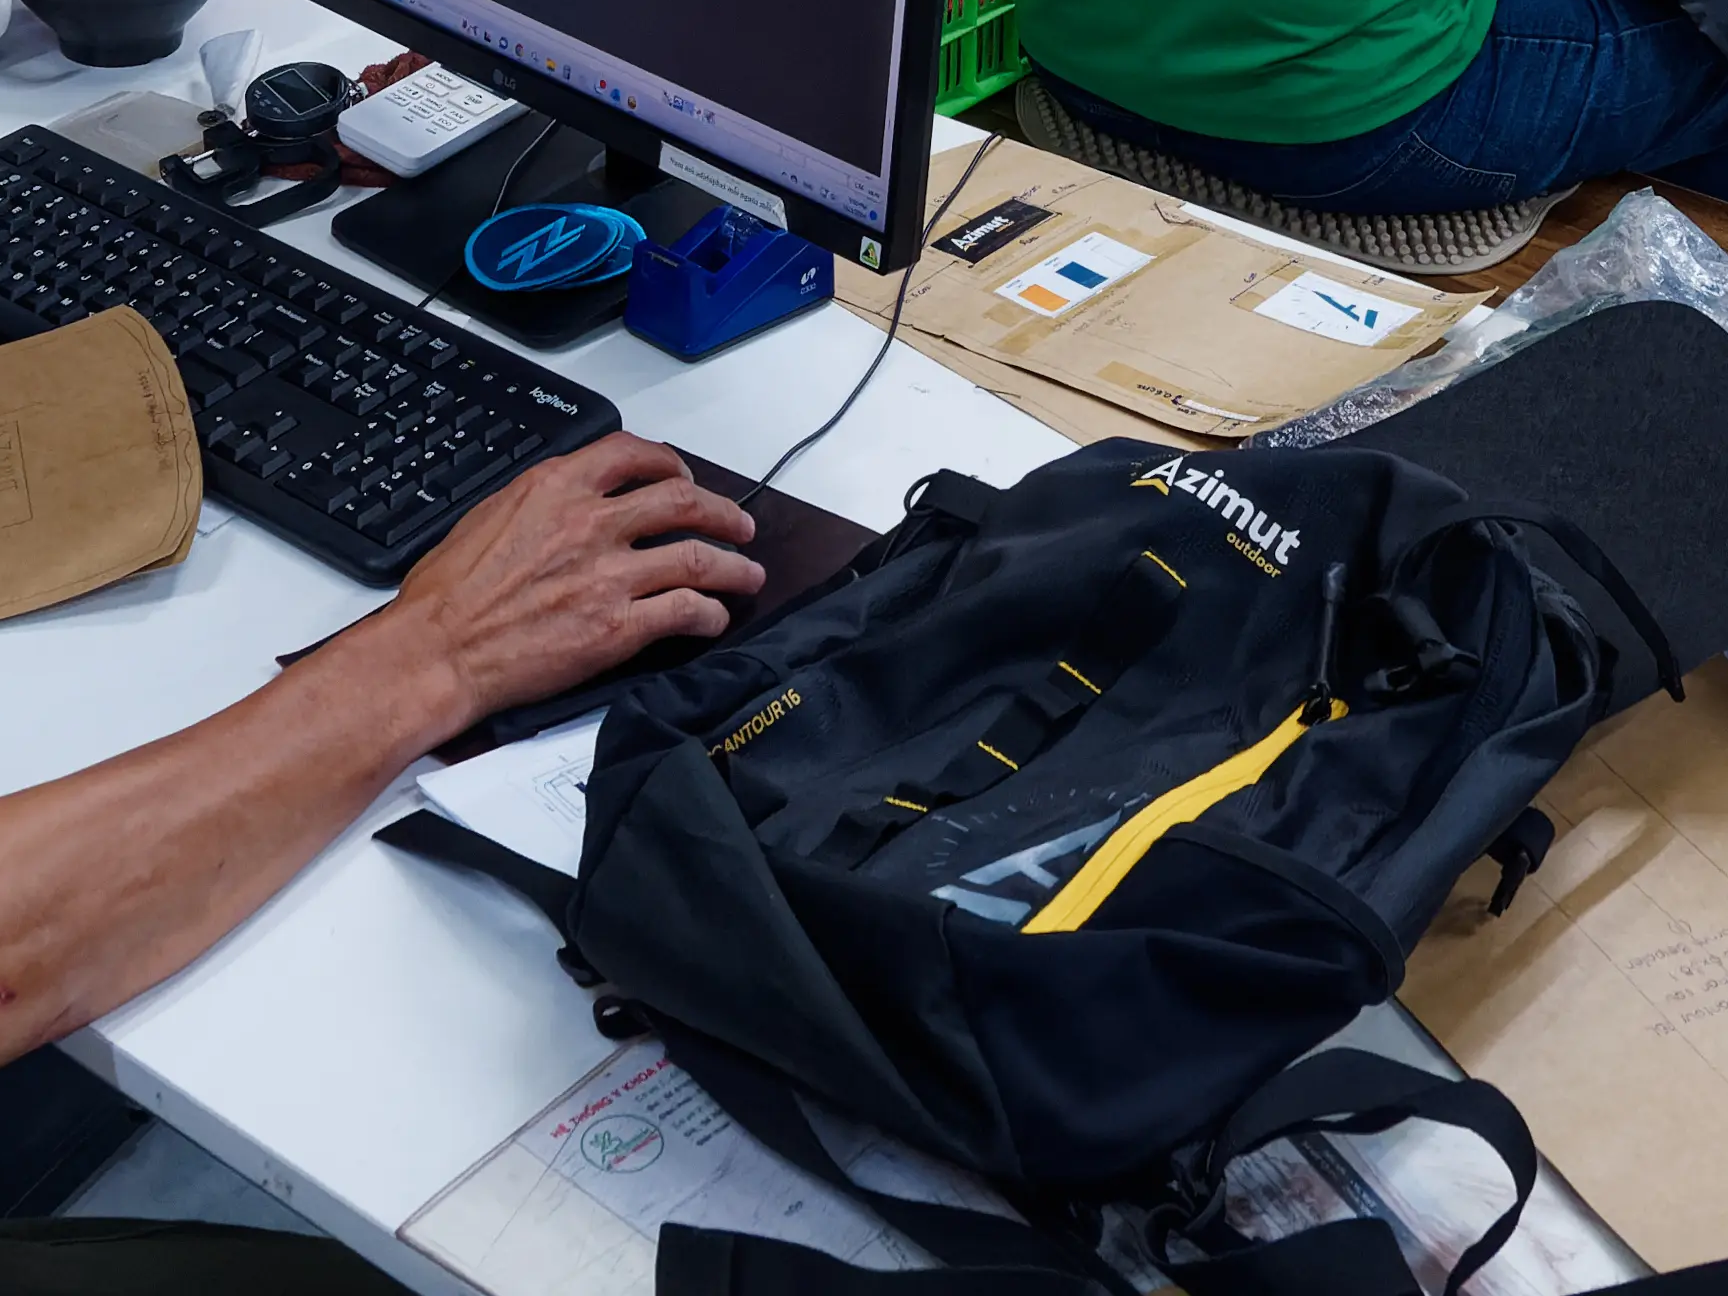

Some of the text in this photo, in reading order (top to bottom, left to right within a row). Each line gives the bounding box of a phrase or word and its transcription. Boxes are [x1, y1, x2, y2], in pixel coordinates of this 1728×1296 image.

[503, 77, 517, 90] LG
[528, 386, 579, 416] logitech
[1140, 455, 1301, 566] Azimut
[1226, 531, 1282, 580] outdoor
[781, 688, 801, 709] 16
